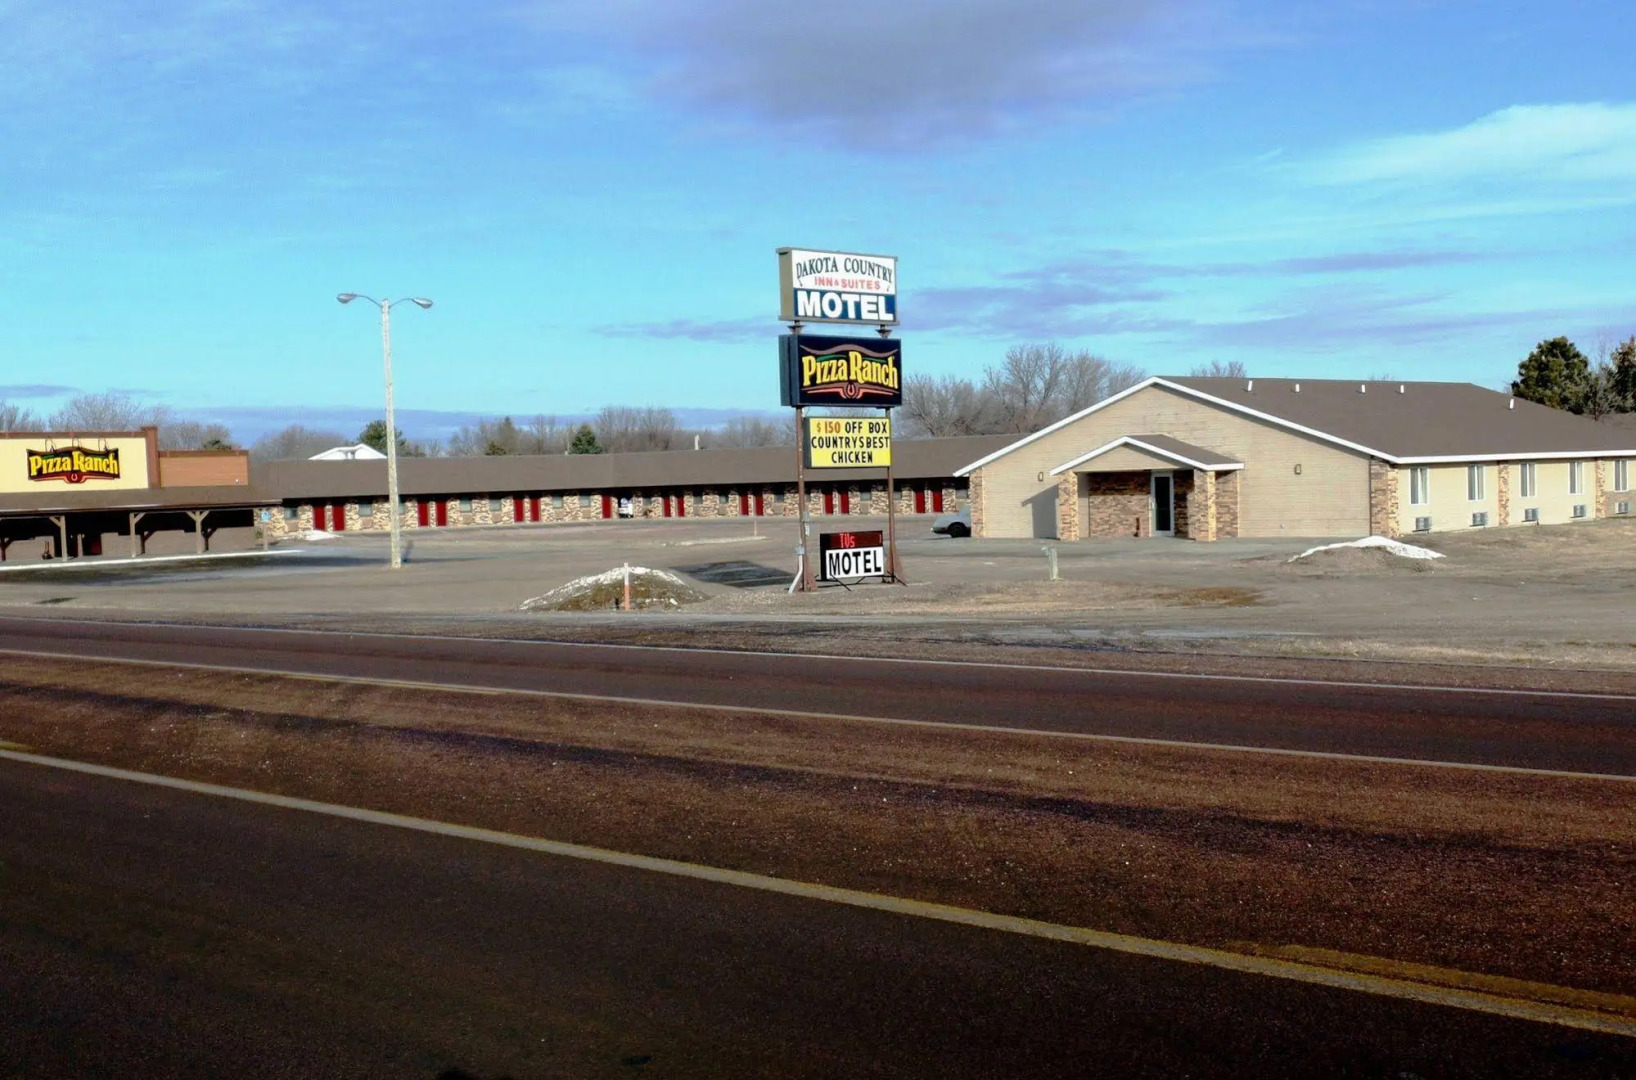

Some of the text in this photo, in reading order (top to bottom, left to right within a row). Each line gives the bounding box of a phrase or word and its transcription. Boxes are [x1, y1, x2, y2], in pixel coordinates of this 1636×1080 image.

[796, 256, 892, 283] DAKOTA COUNTRY
[814, 276, 833, 287] INN
[841, 278, 881, 290] SUITES
[797, 290, 893, 321] MOTEL
[802, 351, 898, 389] Pizza Ranch
[845, 421, 863, 434] OFF
[868, 421, 887, 434] BOX
[29, 450, 119, 476] Pizza Ranch
[831, 451, 873, 464] CHICKEN
[828, 550, 882, 576] MOTEL
